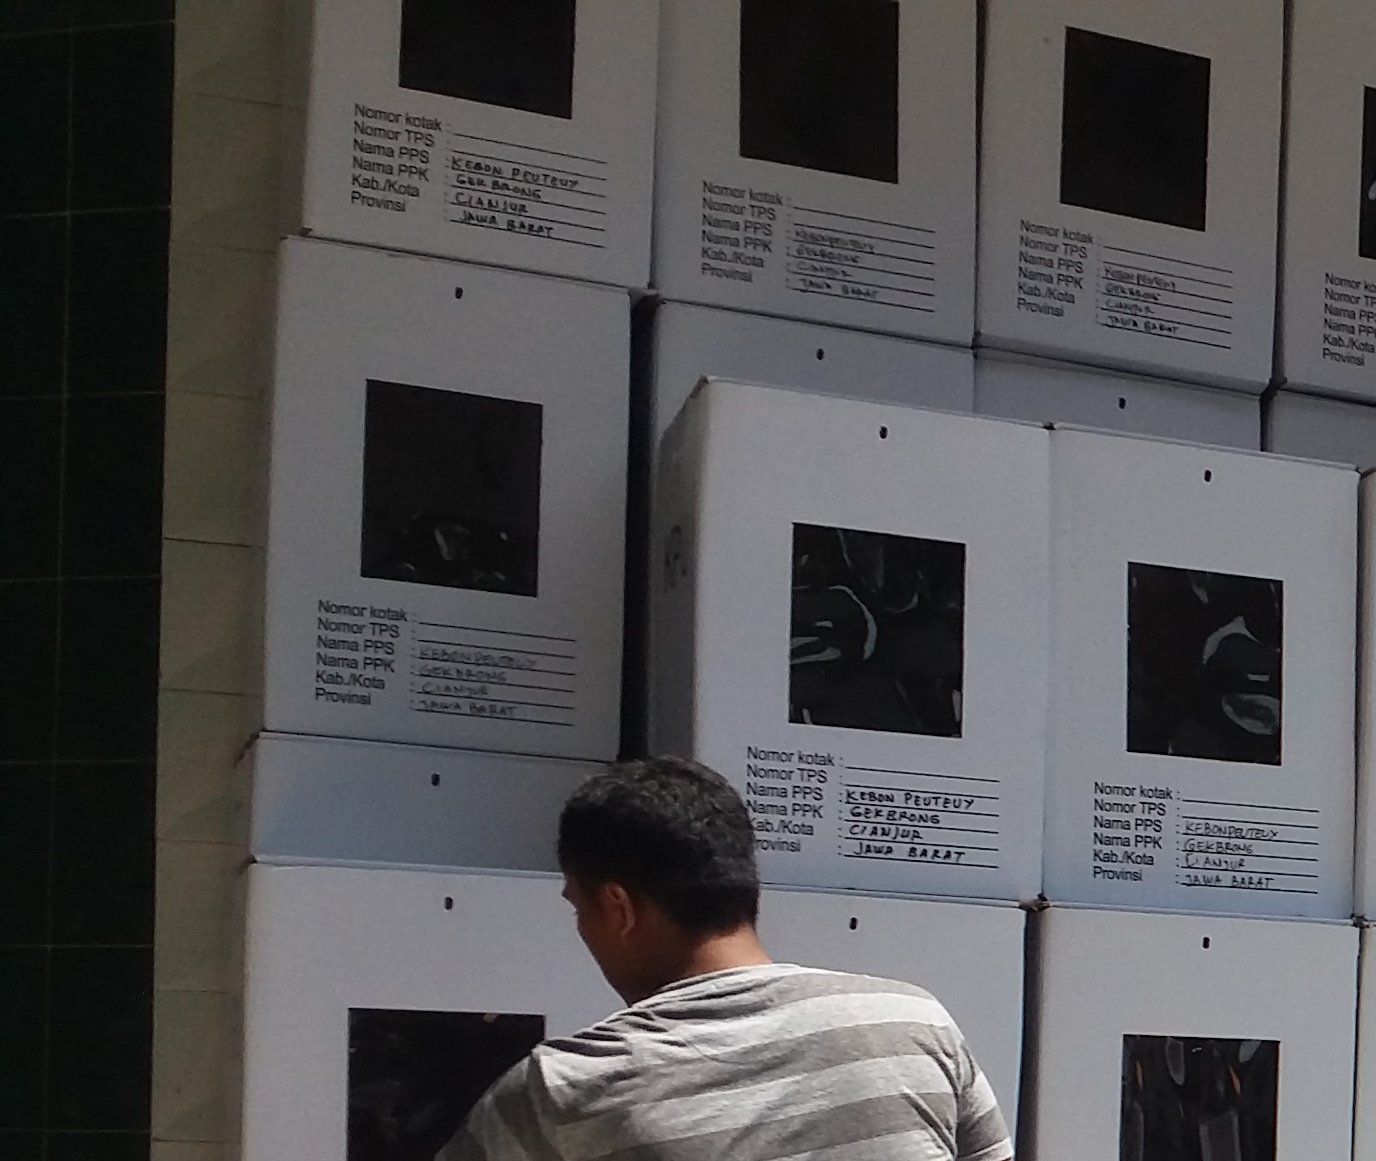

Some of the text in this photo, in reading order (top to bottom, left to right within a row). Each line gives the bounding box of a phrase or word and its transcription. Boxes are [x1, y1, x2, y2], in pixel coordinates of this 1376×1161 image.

[354, 103, 442, 131] Nomor kotak
[354, 121, 434, 147] Nomor TPS
[353, 138, 429, 164] Nama PPS
[352, 156, 429, 181] Nama PPK
[351, 191, 406, 212] Provinsi
[747, 746, 834, 766] Nomor kotak
[747, 764, 827, 783] Nomor TPS
[746, 782, 823, 801] Nama PPS
[744, 799, 823, 818] Nama PPK
[755, 837, 800, 851] rovinsi
